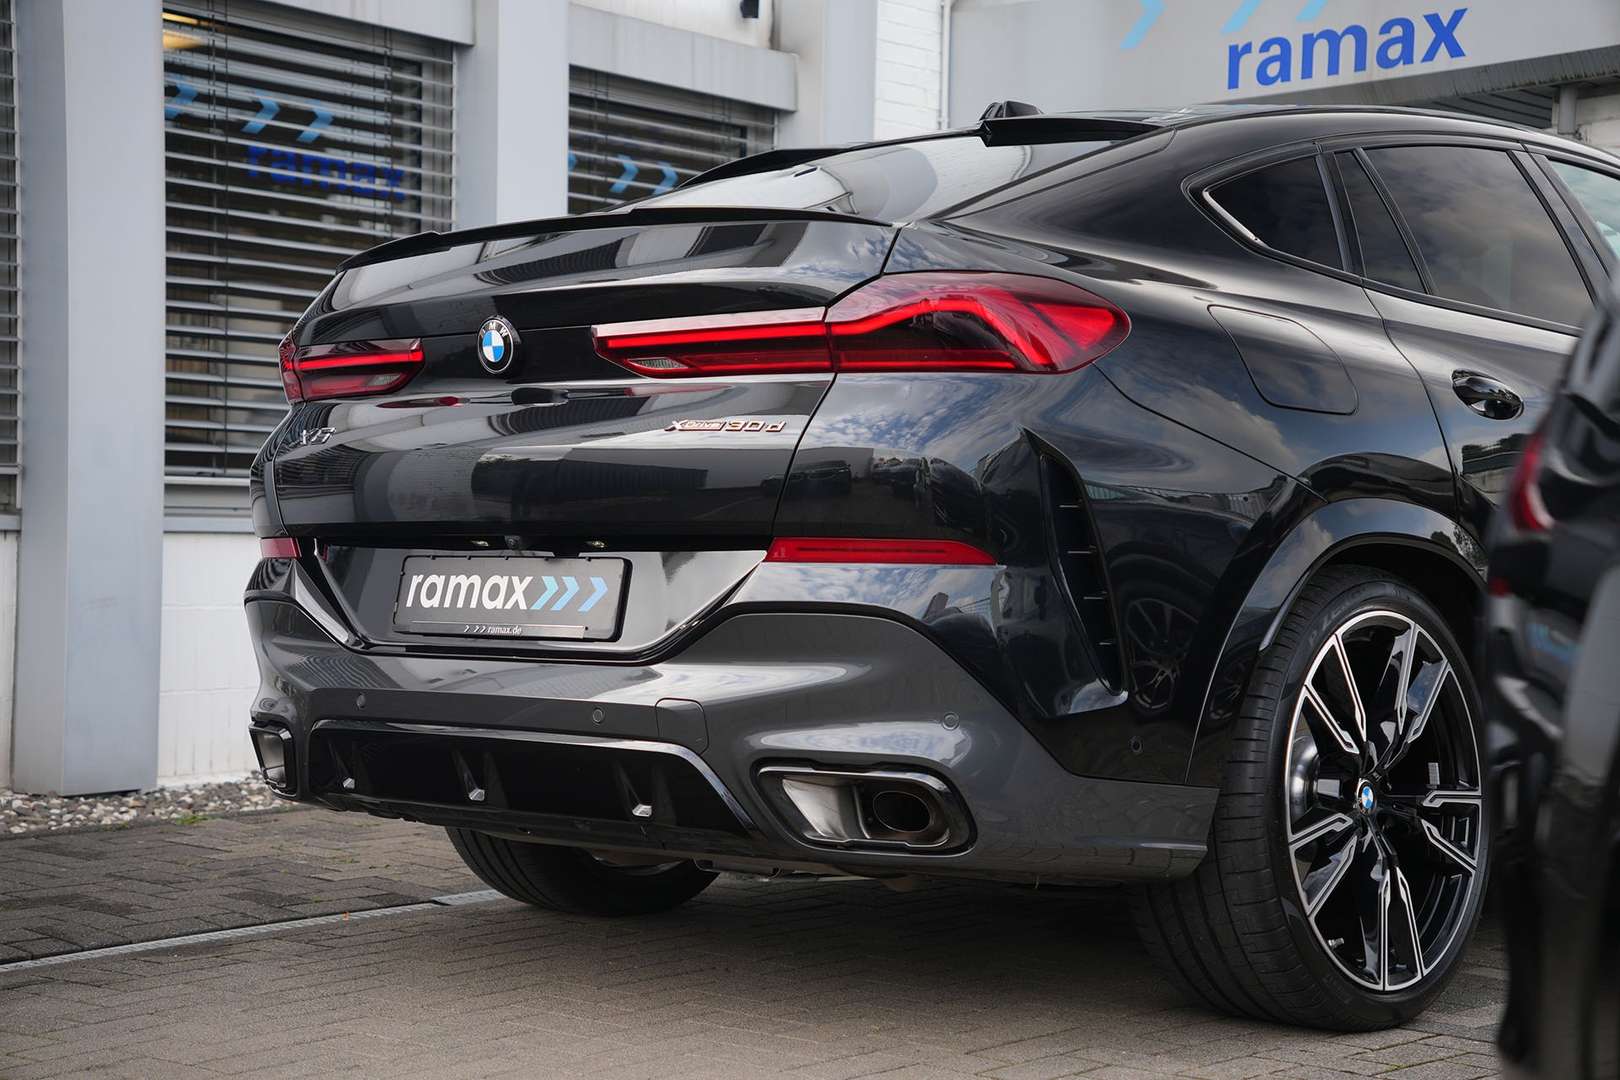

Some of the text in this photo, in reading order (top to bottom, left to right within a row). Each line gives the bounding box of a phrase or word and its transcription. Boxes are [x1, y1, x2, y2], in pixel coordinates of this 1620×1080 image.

[1227, 7, 1468, 90] ramax
[247, 145, 404, 203] ramax
[405, 574, 533, 610] ramax
[487, 625, 522, 635] ramax.de
